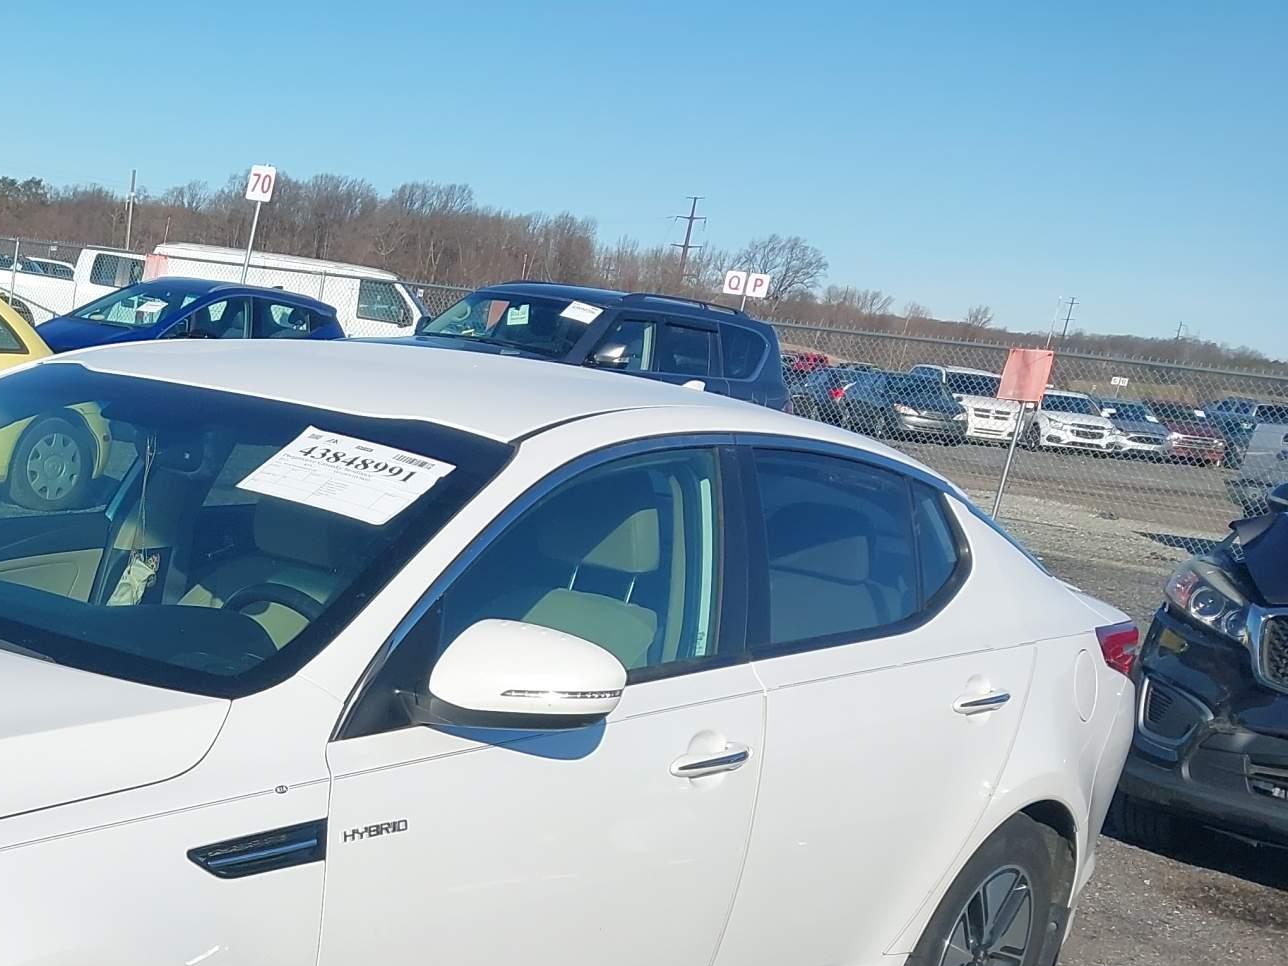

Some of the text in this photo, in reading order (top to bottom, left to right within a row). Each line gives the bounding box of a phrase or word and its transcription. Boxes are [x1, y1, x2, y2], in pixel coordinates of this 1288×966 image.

[251, 173, 272, 194] 70
[728, 275, 764, 292] Q P
[299, 444, 417, 483] 43848991
[343, 819, 408, 842] HYBRID
